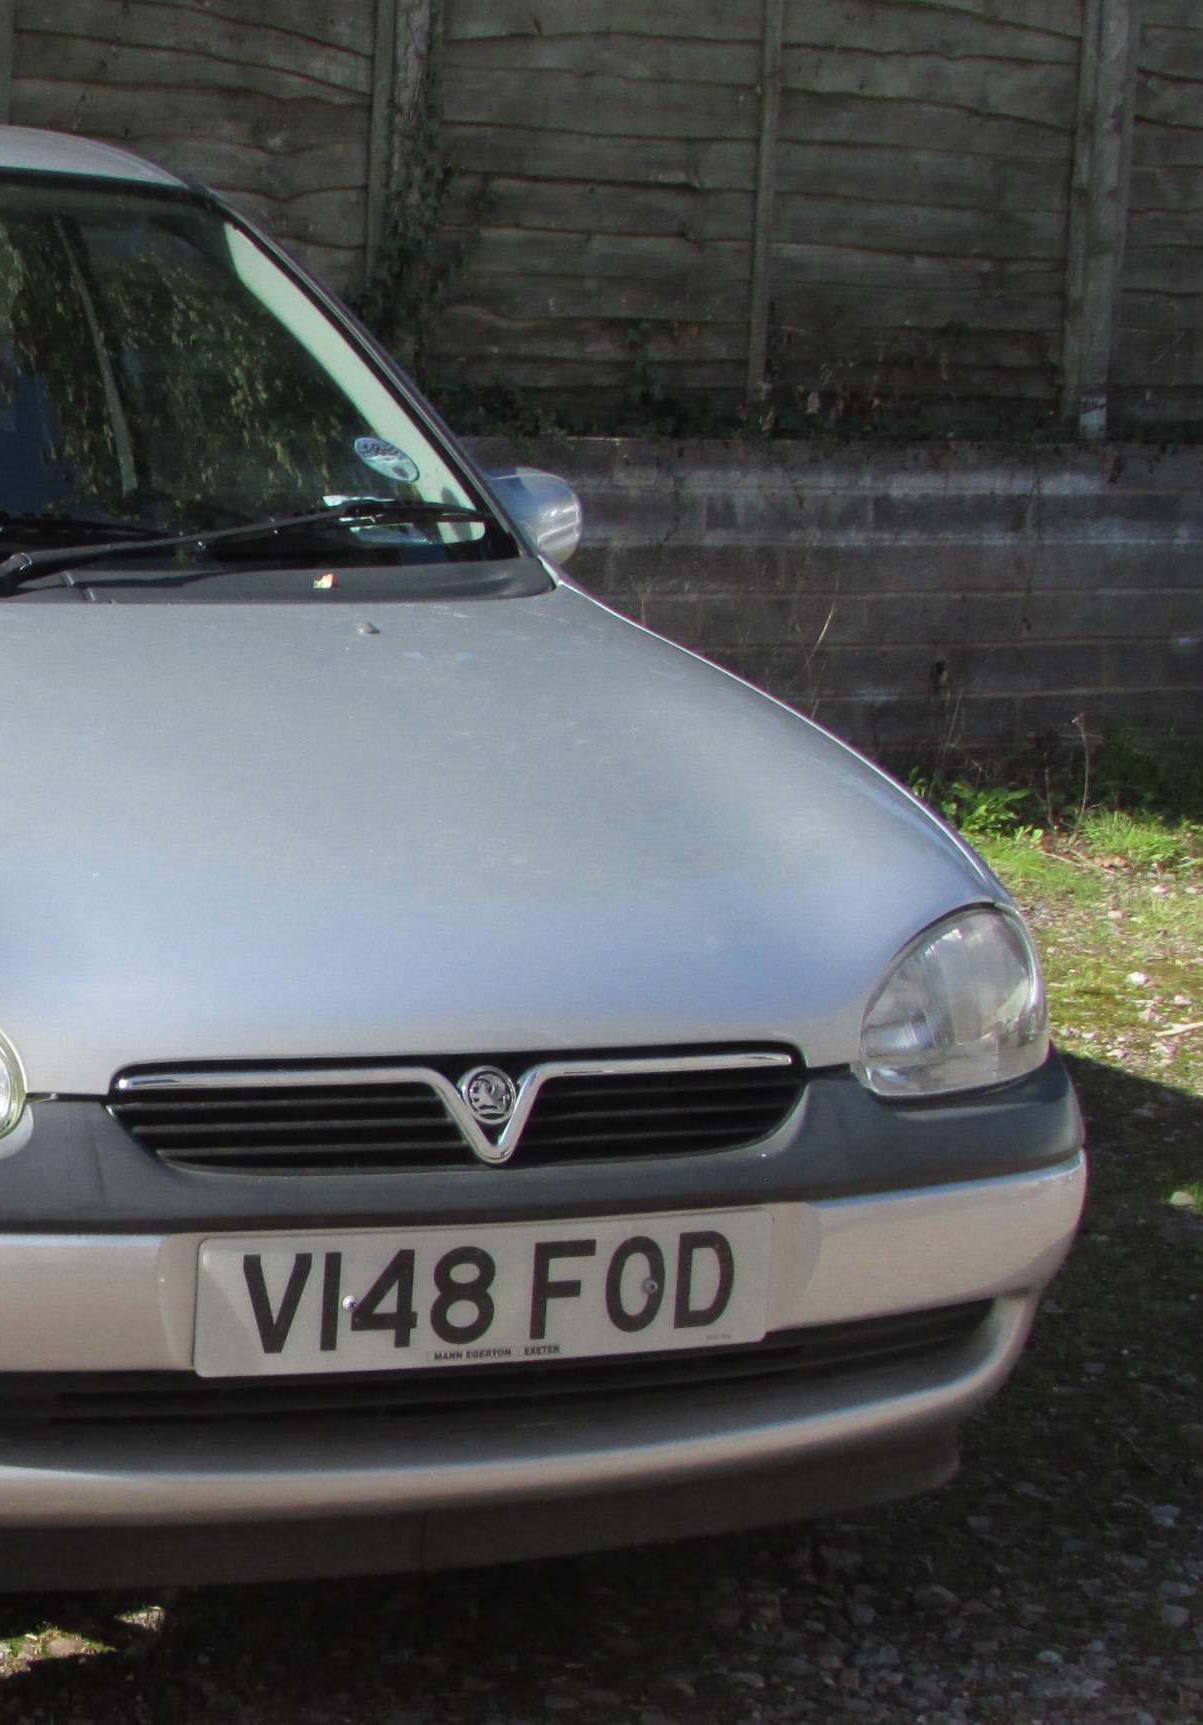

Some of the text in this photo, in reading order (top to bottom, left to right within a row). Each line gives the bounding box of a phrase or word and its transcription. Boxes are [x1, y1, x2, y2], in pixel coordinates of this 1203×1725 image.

[243, 1230, 734, 1353] V148 FOD
[433, 1345, 561, 1361] MANN EGERTON EXETER
